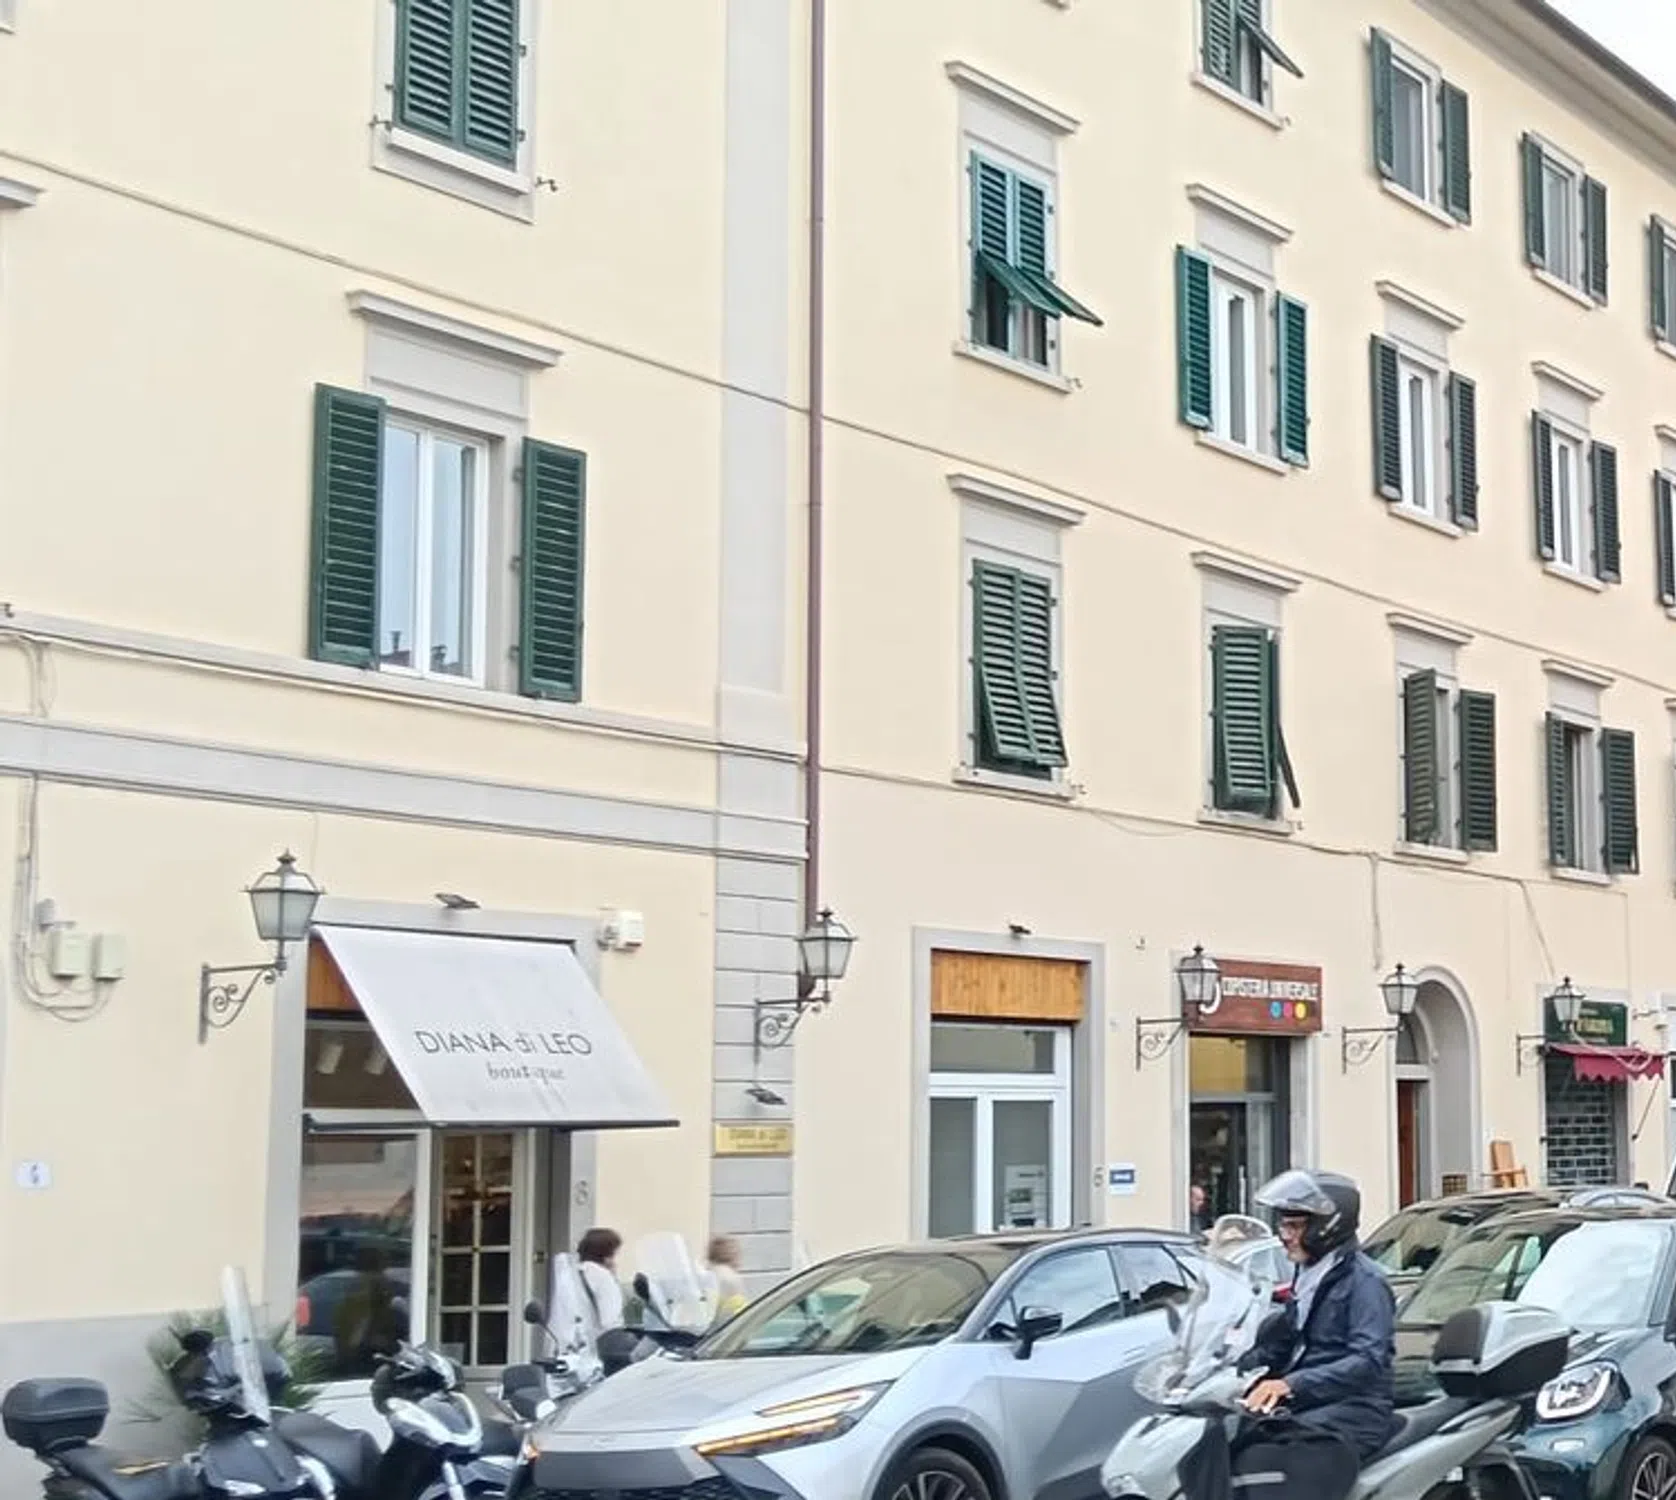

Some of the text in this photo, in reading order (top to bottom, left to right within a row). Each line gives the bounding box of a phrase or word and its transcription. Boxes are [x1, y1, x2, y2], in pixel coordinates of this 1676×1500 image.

[415, 1030, 593, 1055] DIANA di LEO
